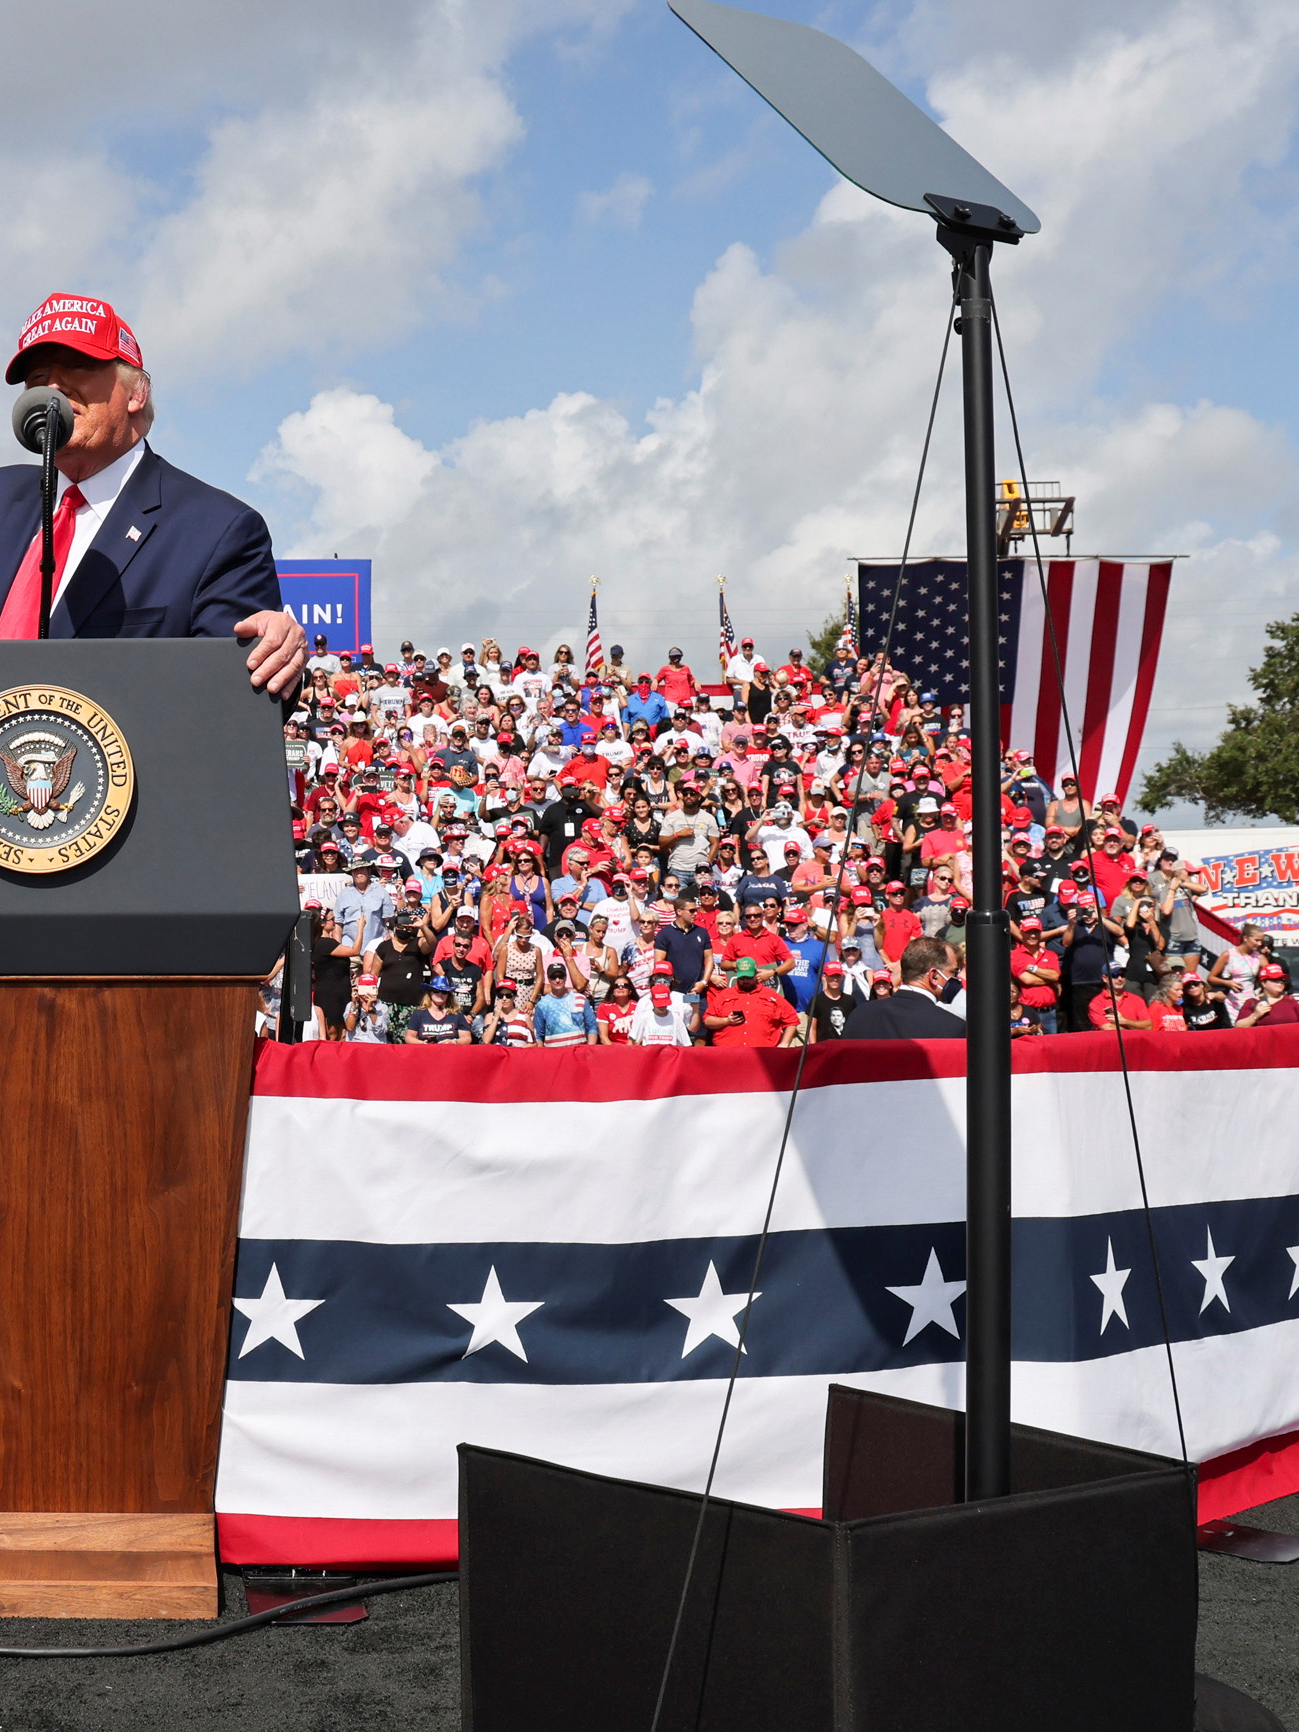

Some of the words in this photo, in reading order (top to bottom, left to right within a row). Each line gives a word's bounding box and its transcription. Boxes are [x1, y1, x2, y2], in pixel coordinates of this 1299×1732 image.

[42, 299, 106, 317] AMERICA
[51, 317, 97, 335] AGAIN
[283, 603, 343, 624] AIN!
[38, 693, 56, 706] OF
[59, 697, 83, 715] THE
[86, 711, 128, 788] UNITED
[57, 804, 120, 864] STATES
[423, 1024, 453, 1032] TRUMP
